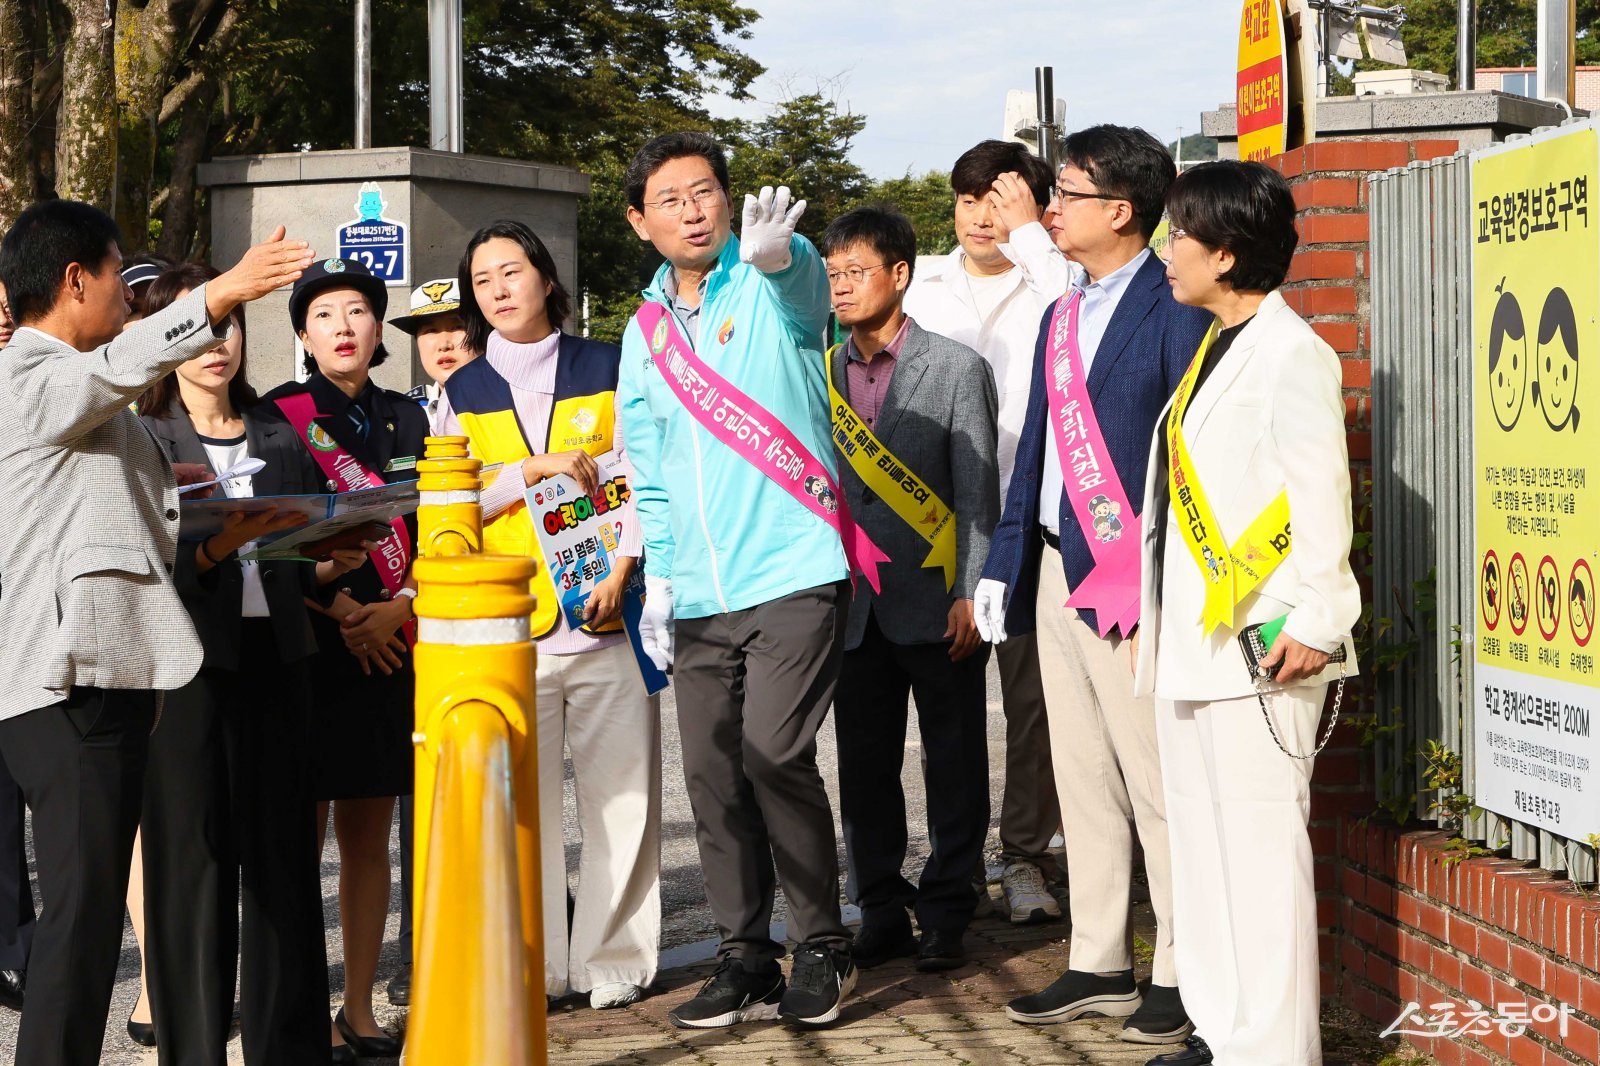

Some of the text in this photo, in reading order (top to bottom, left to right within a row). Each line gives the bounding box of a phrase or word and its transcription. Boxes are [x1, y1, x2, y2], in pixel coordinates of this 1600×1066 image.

[1245, 0, 1270, 46] 학교앞
[1238, 72, 1281, 118] 어린이보호구역
[1477, 174, 1589, 245] 교육환경보호구역
[345, 225, 398, 237] 중부대로2517번길
[665, 342, 805, 480] 스쿨존에서는 어린이가 주인공
[1059, 398, 1089, 447] 우리가
[332, 454, 375, 492] 스쿨존
[836, 404, 931, 506] 우리 함께 만들어요
[1069, 443, 1107, 493] 지켜요
[1485, 466, 1500, 486] 여기는
[1502, 466, 1518, 487] 학생의
[1519, 467, 1537, 487] 학습과
[543, 495, 595, 536] 어린이
[1492, 490, 1576, 514] 나쁜 영향을 주는 행위 및 시설을
[1506, 515, 1528, 536] 제한하는
[554, 547, 575, 567] 1단
[574, 536, 600, 560] 멈춤!
[561, 557, 607, 590] 3초 동안!
[1482, 636, 1501, 657] 오염물질
[1538, 646, 1560, 669] 유해시설
[1569, 652, 1594, 675] 유해행위
[1484, 683, 1590, 738] 학교 경계선으로부터 200M
[1514, 789, 1561, 825] 제일초등학교장
